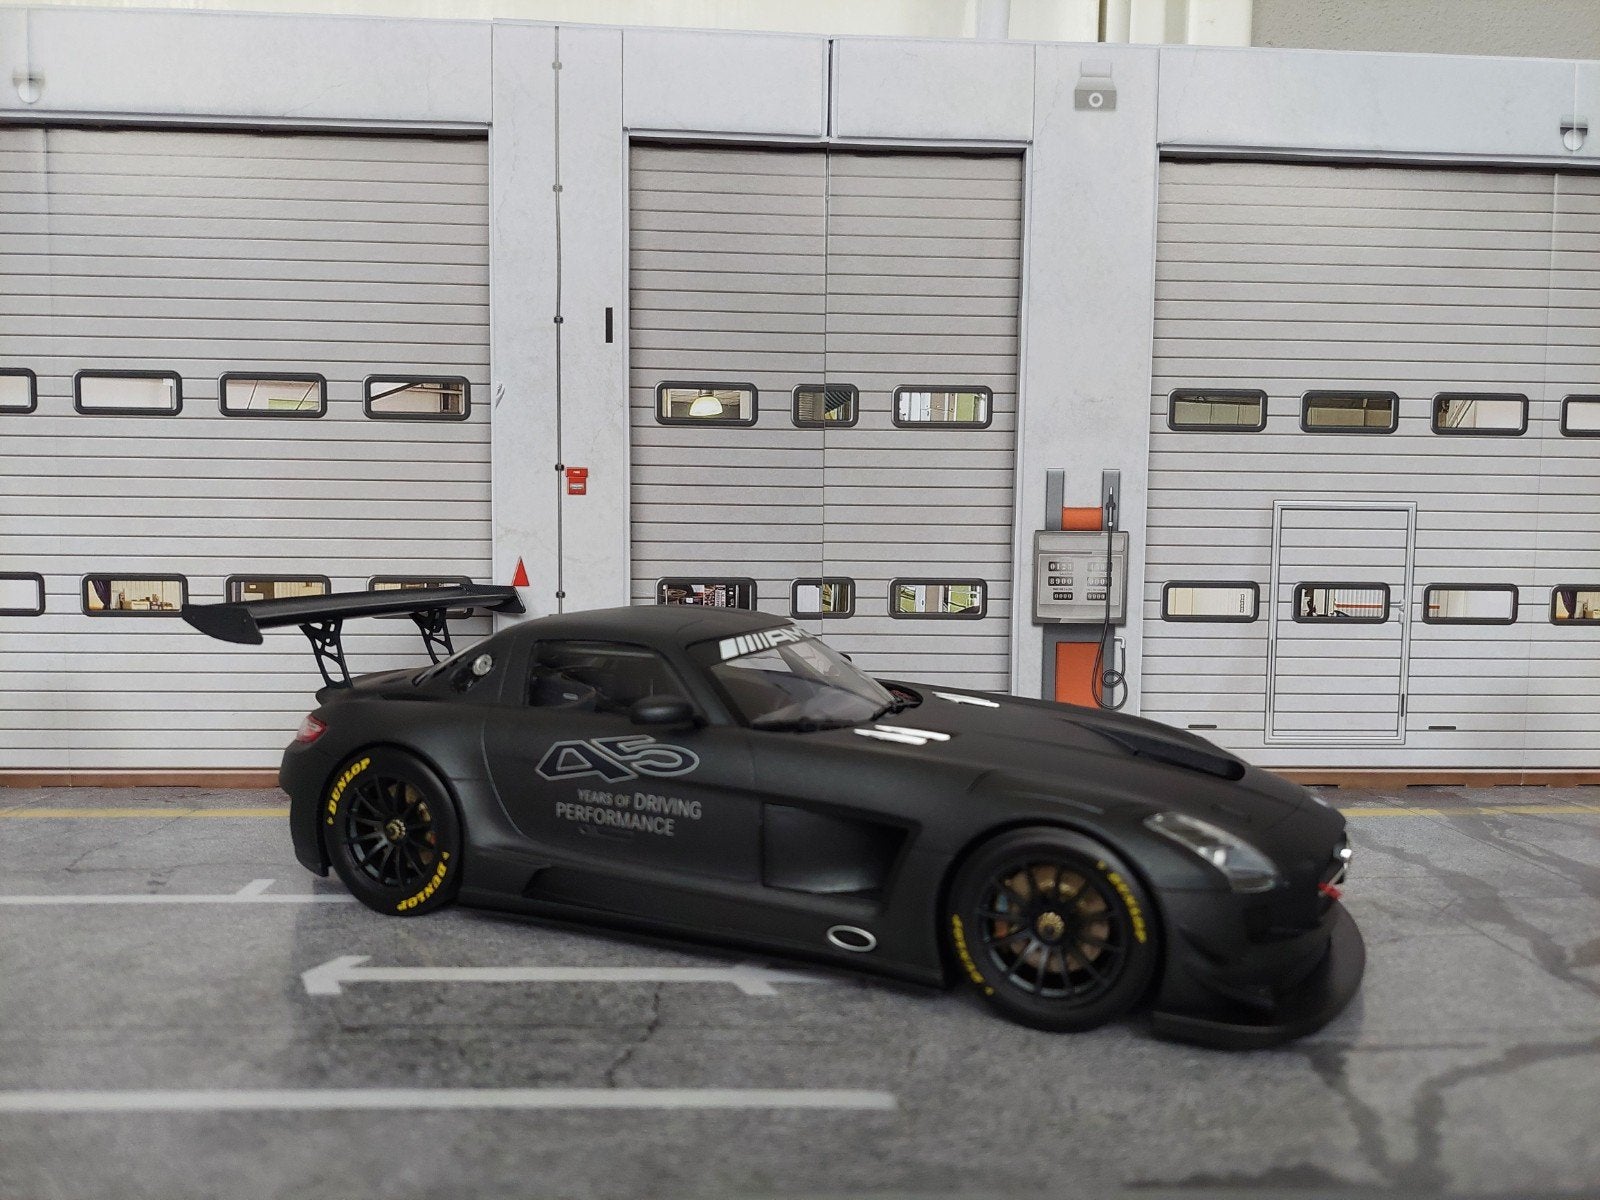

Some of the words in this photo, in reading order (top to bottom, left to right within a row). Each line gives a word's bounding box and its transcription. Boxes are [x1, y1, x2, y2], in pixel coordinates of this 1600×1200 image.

[327, 757, 371, 815] DUNLOP
[577, 788, 613, 806] YEARS
[614, 793, 631, 808] OF
[633, 792, 702, 821] DRIVING
[555, 802, 675, 837] PERFORMANCE
[396, 861, 447, 911] DUNLOP
